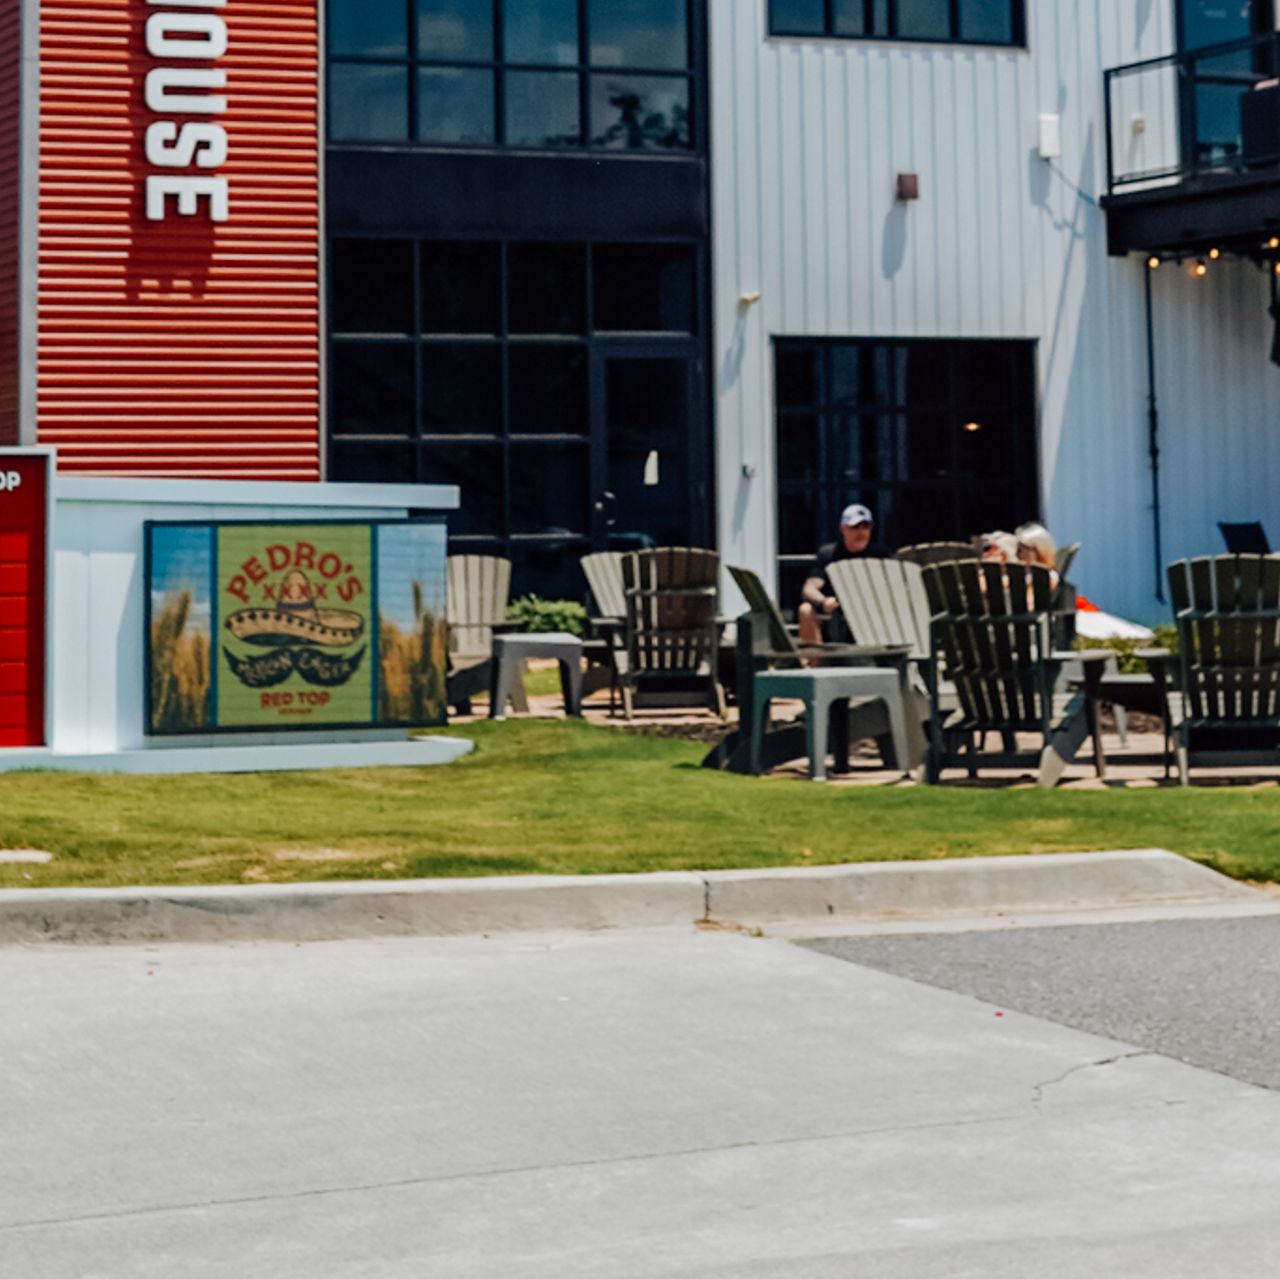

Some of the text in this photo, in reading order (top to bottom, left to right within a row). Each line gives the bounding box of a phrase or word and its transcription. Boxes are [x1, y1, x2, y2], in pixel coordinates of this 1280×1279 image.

[226, 540, 364, 603] PEDRO'S
[260, 690, 331, 708] RED TOP
